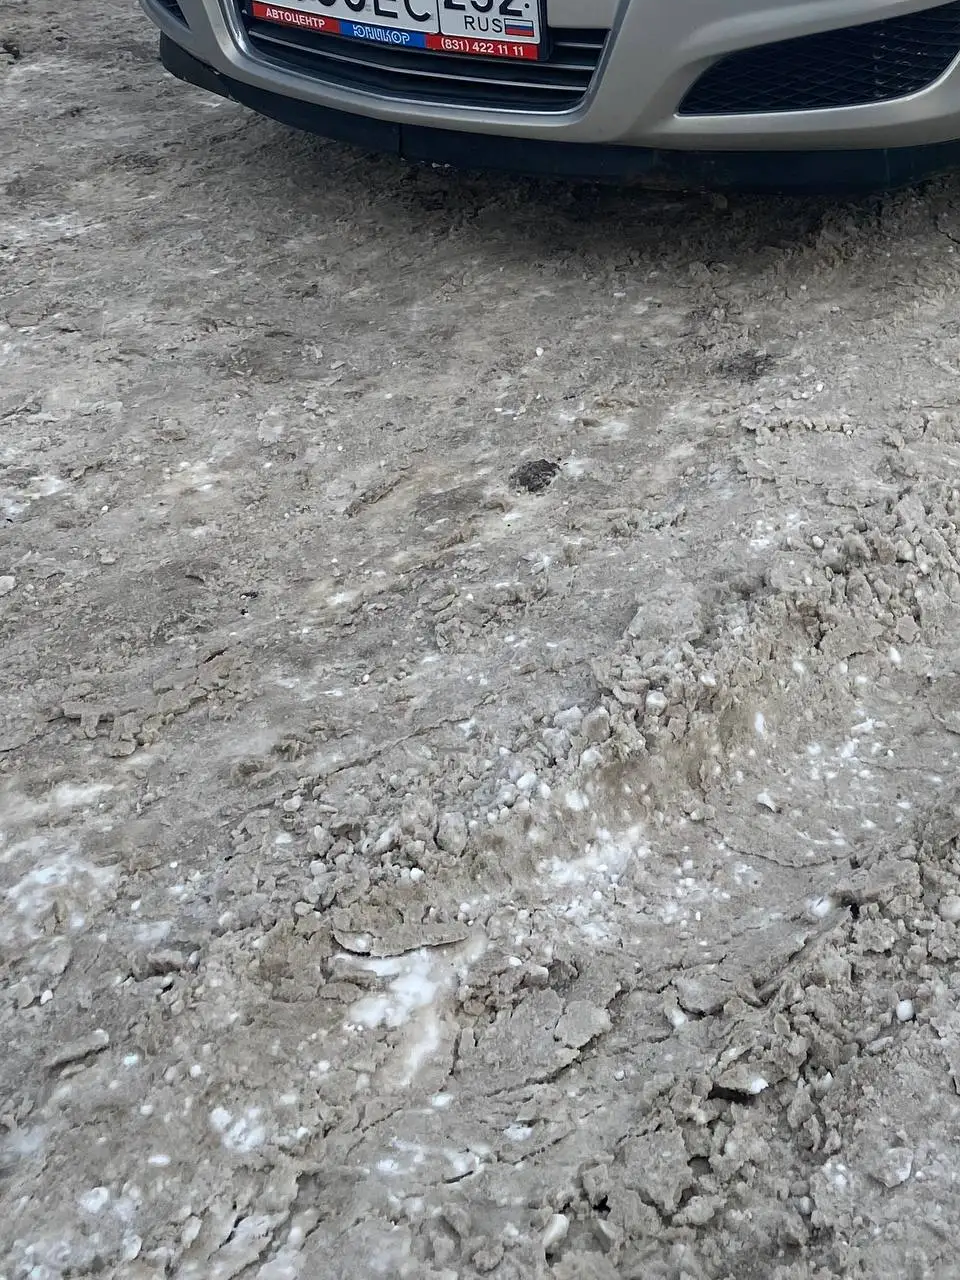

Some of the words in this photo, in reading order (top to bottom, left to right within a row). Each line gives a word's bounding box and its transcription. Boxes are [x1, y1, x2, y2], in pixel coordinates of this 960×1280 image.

[265, 8, 326, 28] АВТОЦЕНТР
[464, 16, 503, 33] RUS
[440, 37, 470, 53] (831)
[472, 41, 495, 55] 422
[497, 43, 510, 55] 11
[512, 45, 525, 57] 11
